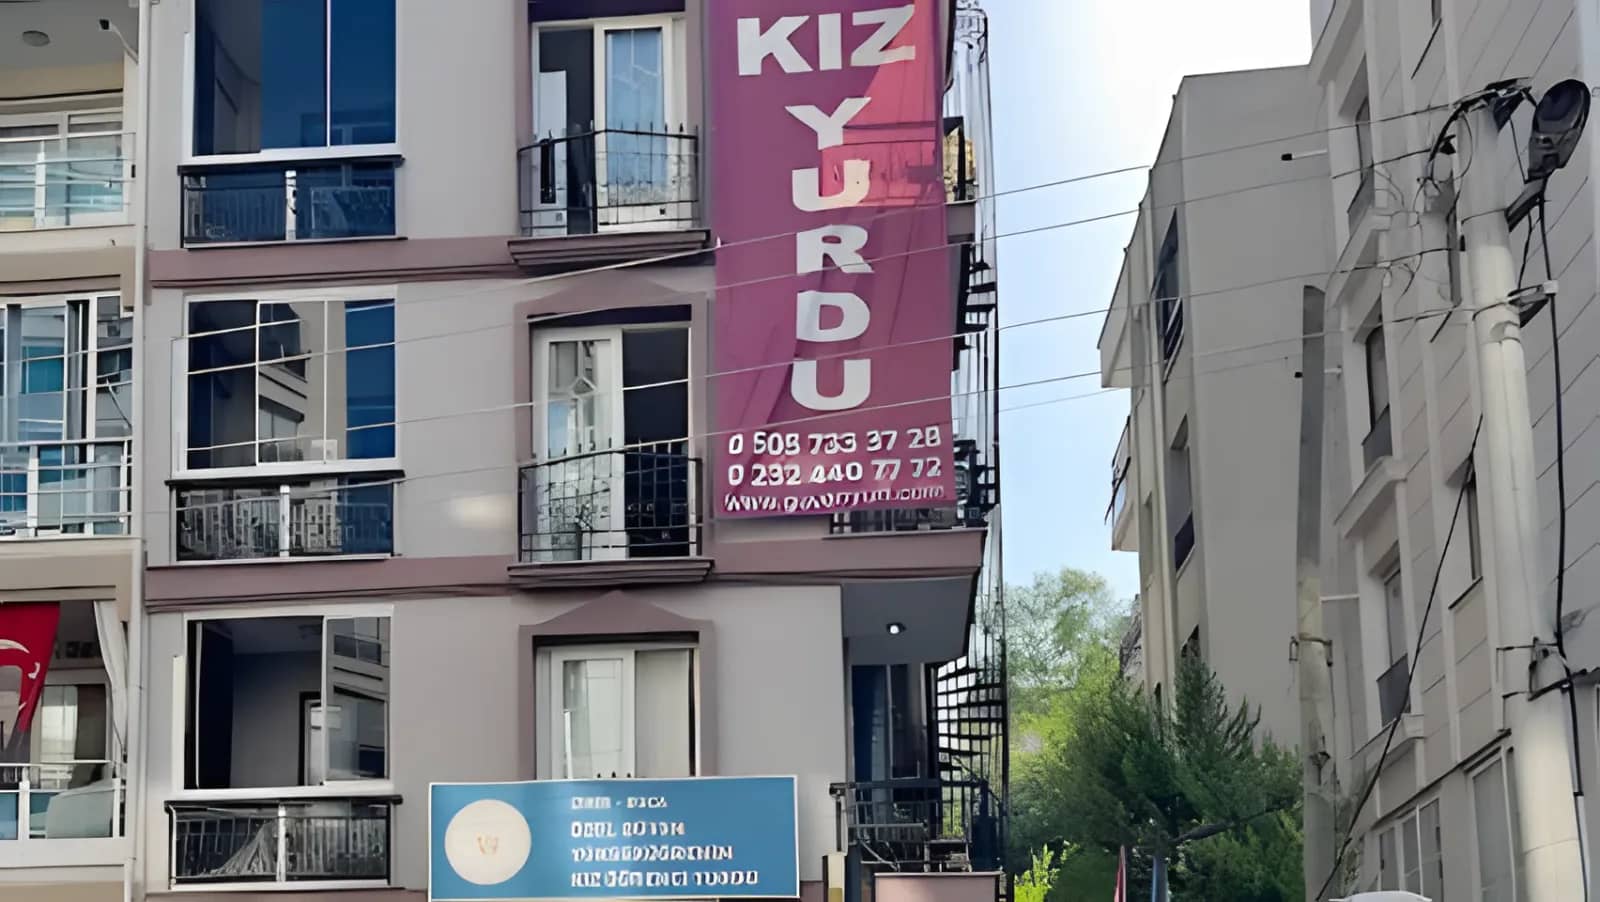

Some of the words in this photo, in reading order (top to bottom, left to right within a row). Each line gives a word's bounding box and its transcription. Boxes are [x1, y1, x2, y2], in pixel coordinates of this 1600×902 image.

[737, 4, 916, 76] KIZ
[785, 96, 875, 411] YURDU
[728, 433, 744, 455] 0
[866, 429, 898, 451] 37
[728, 464, 744, 486] 0
[871, 458, 901, 481] 77
[910, 456, 942, 478] 72
